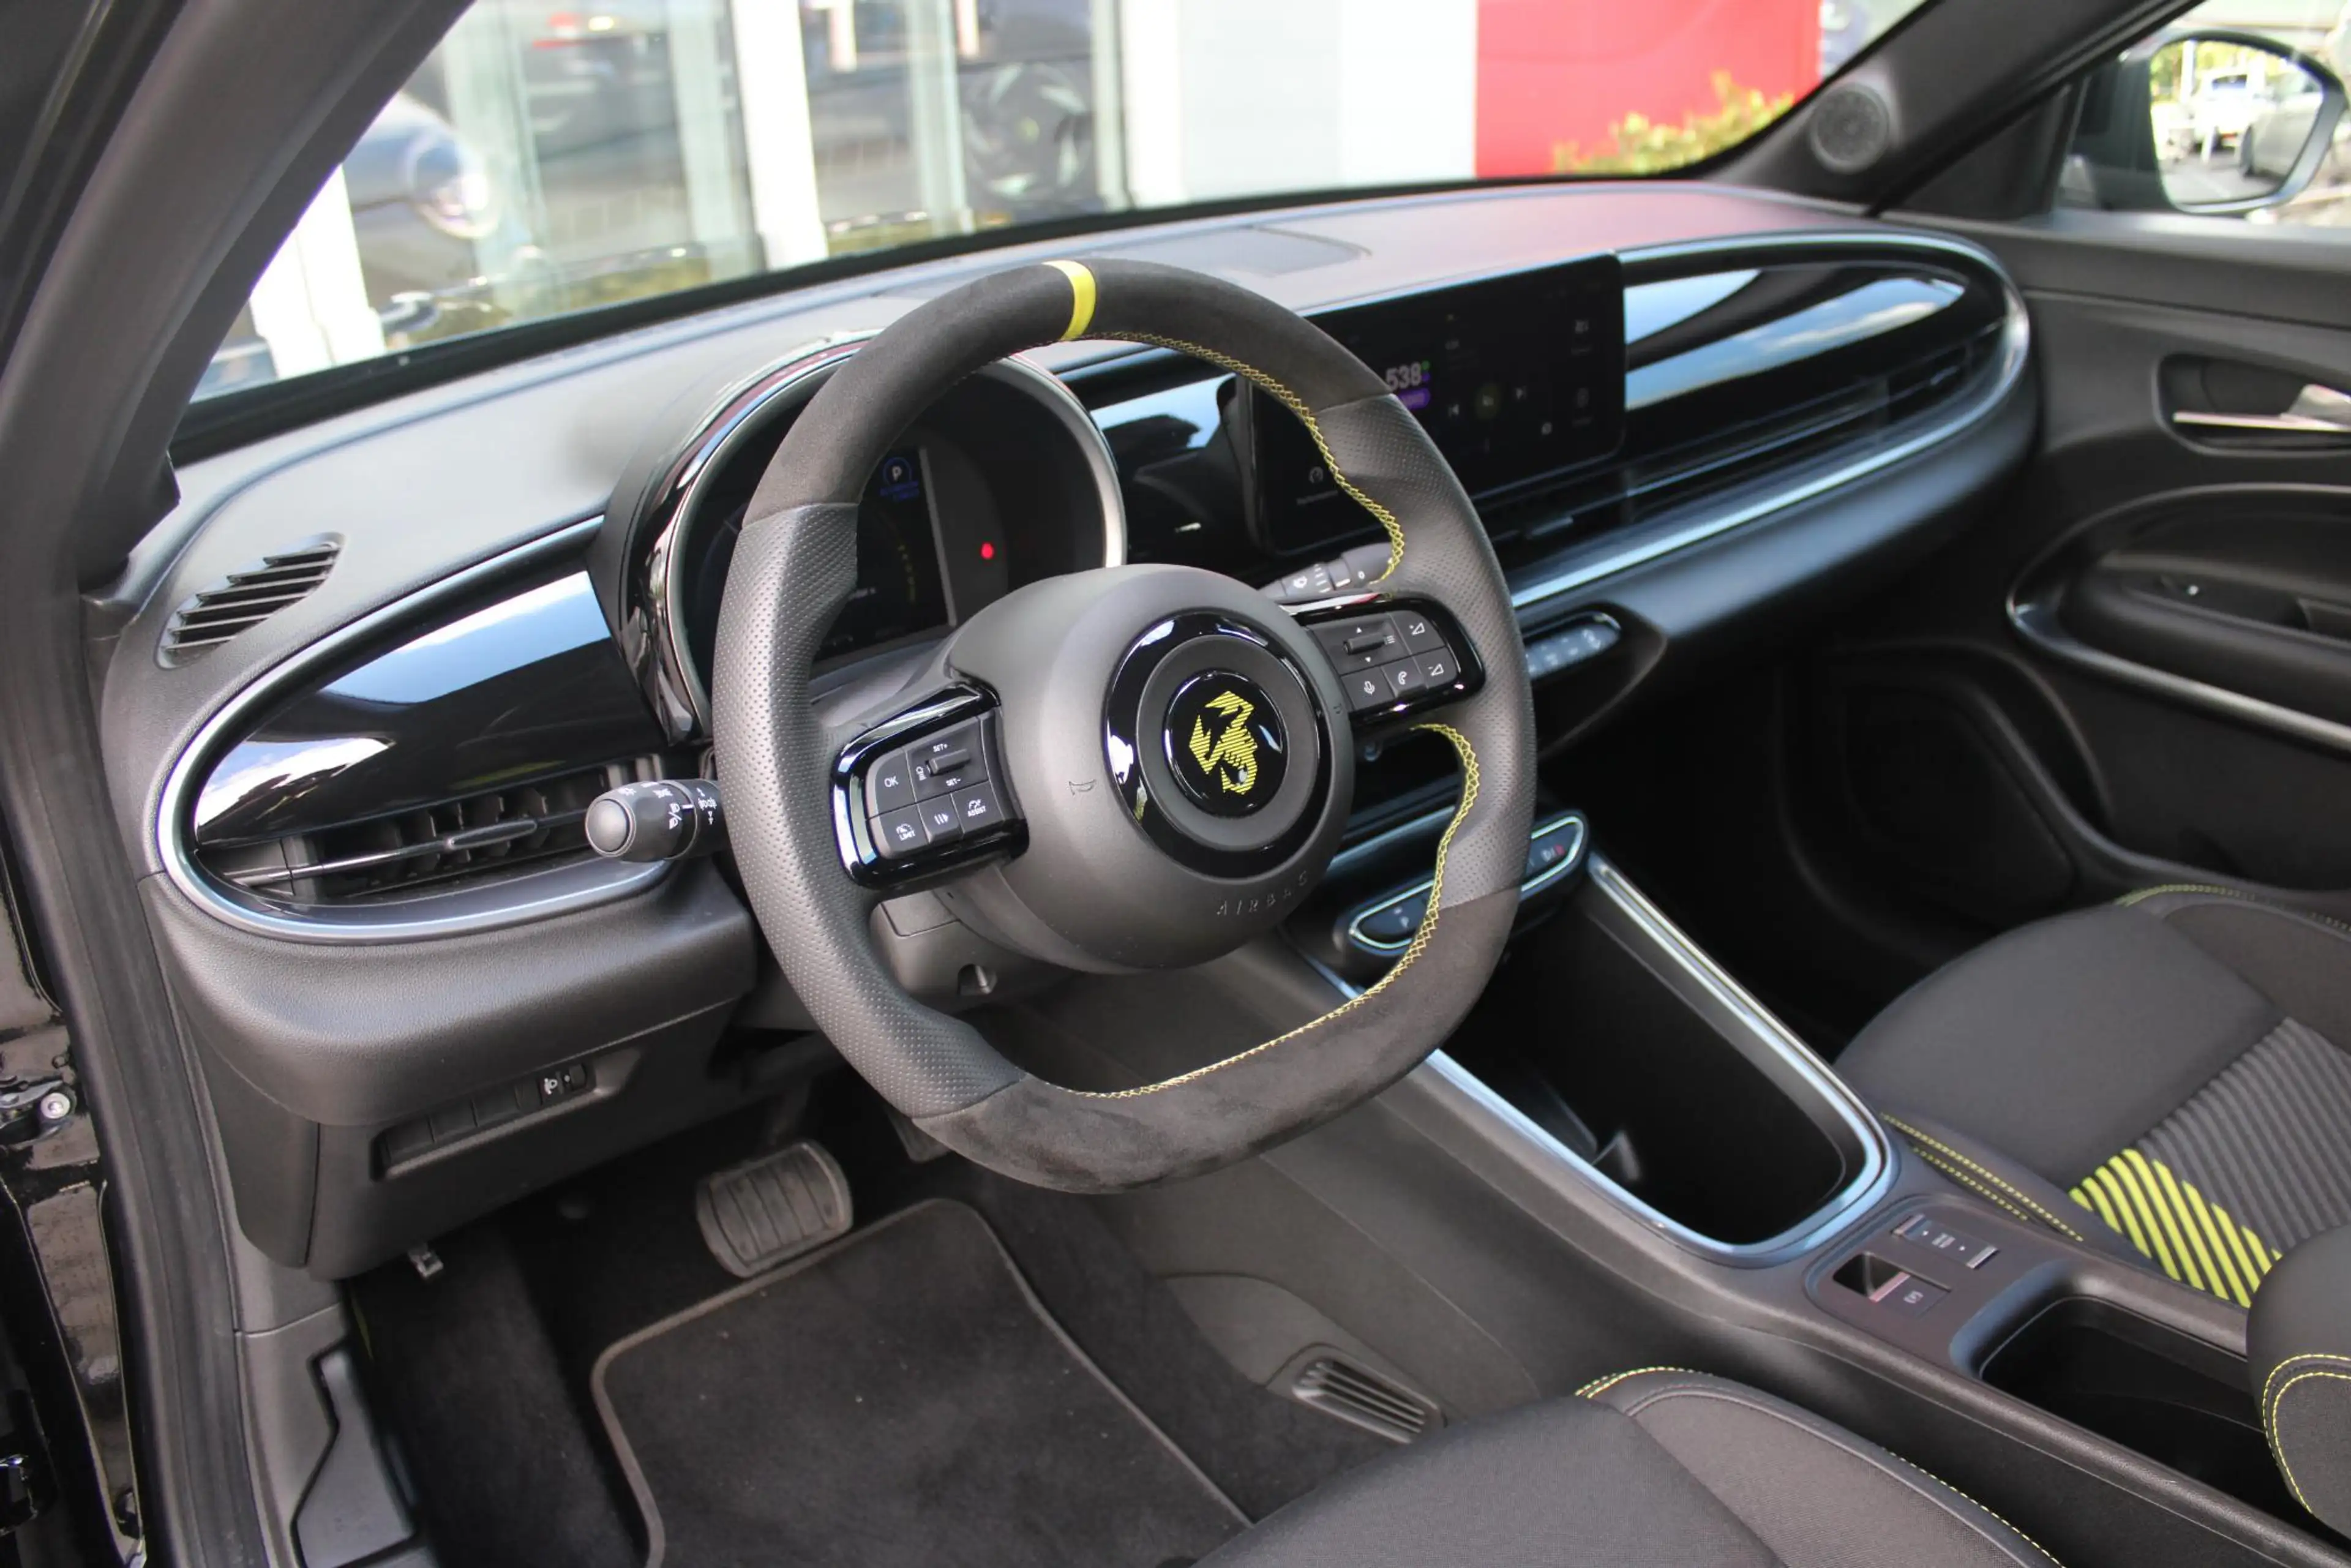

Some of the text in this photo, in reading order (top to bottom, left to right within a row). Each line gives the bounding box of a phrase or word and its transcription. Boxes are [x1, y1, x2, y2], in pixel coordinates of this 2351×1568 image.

[883, 775, 899, 788] OK
[967, 805, 987, 817] ASSIST
[899, 830, 916, 842] LIMIT
